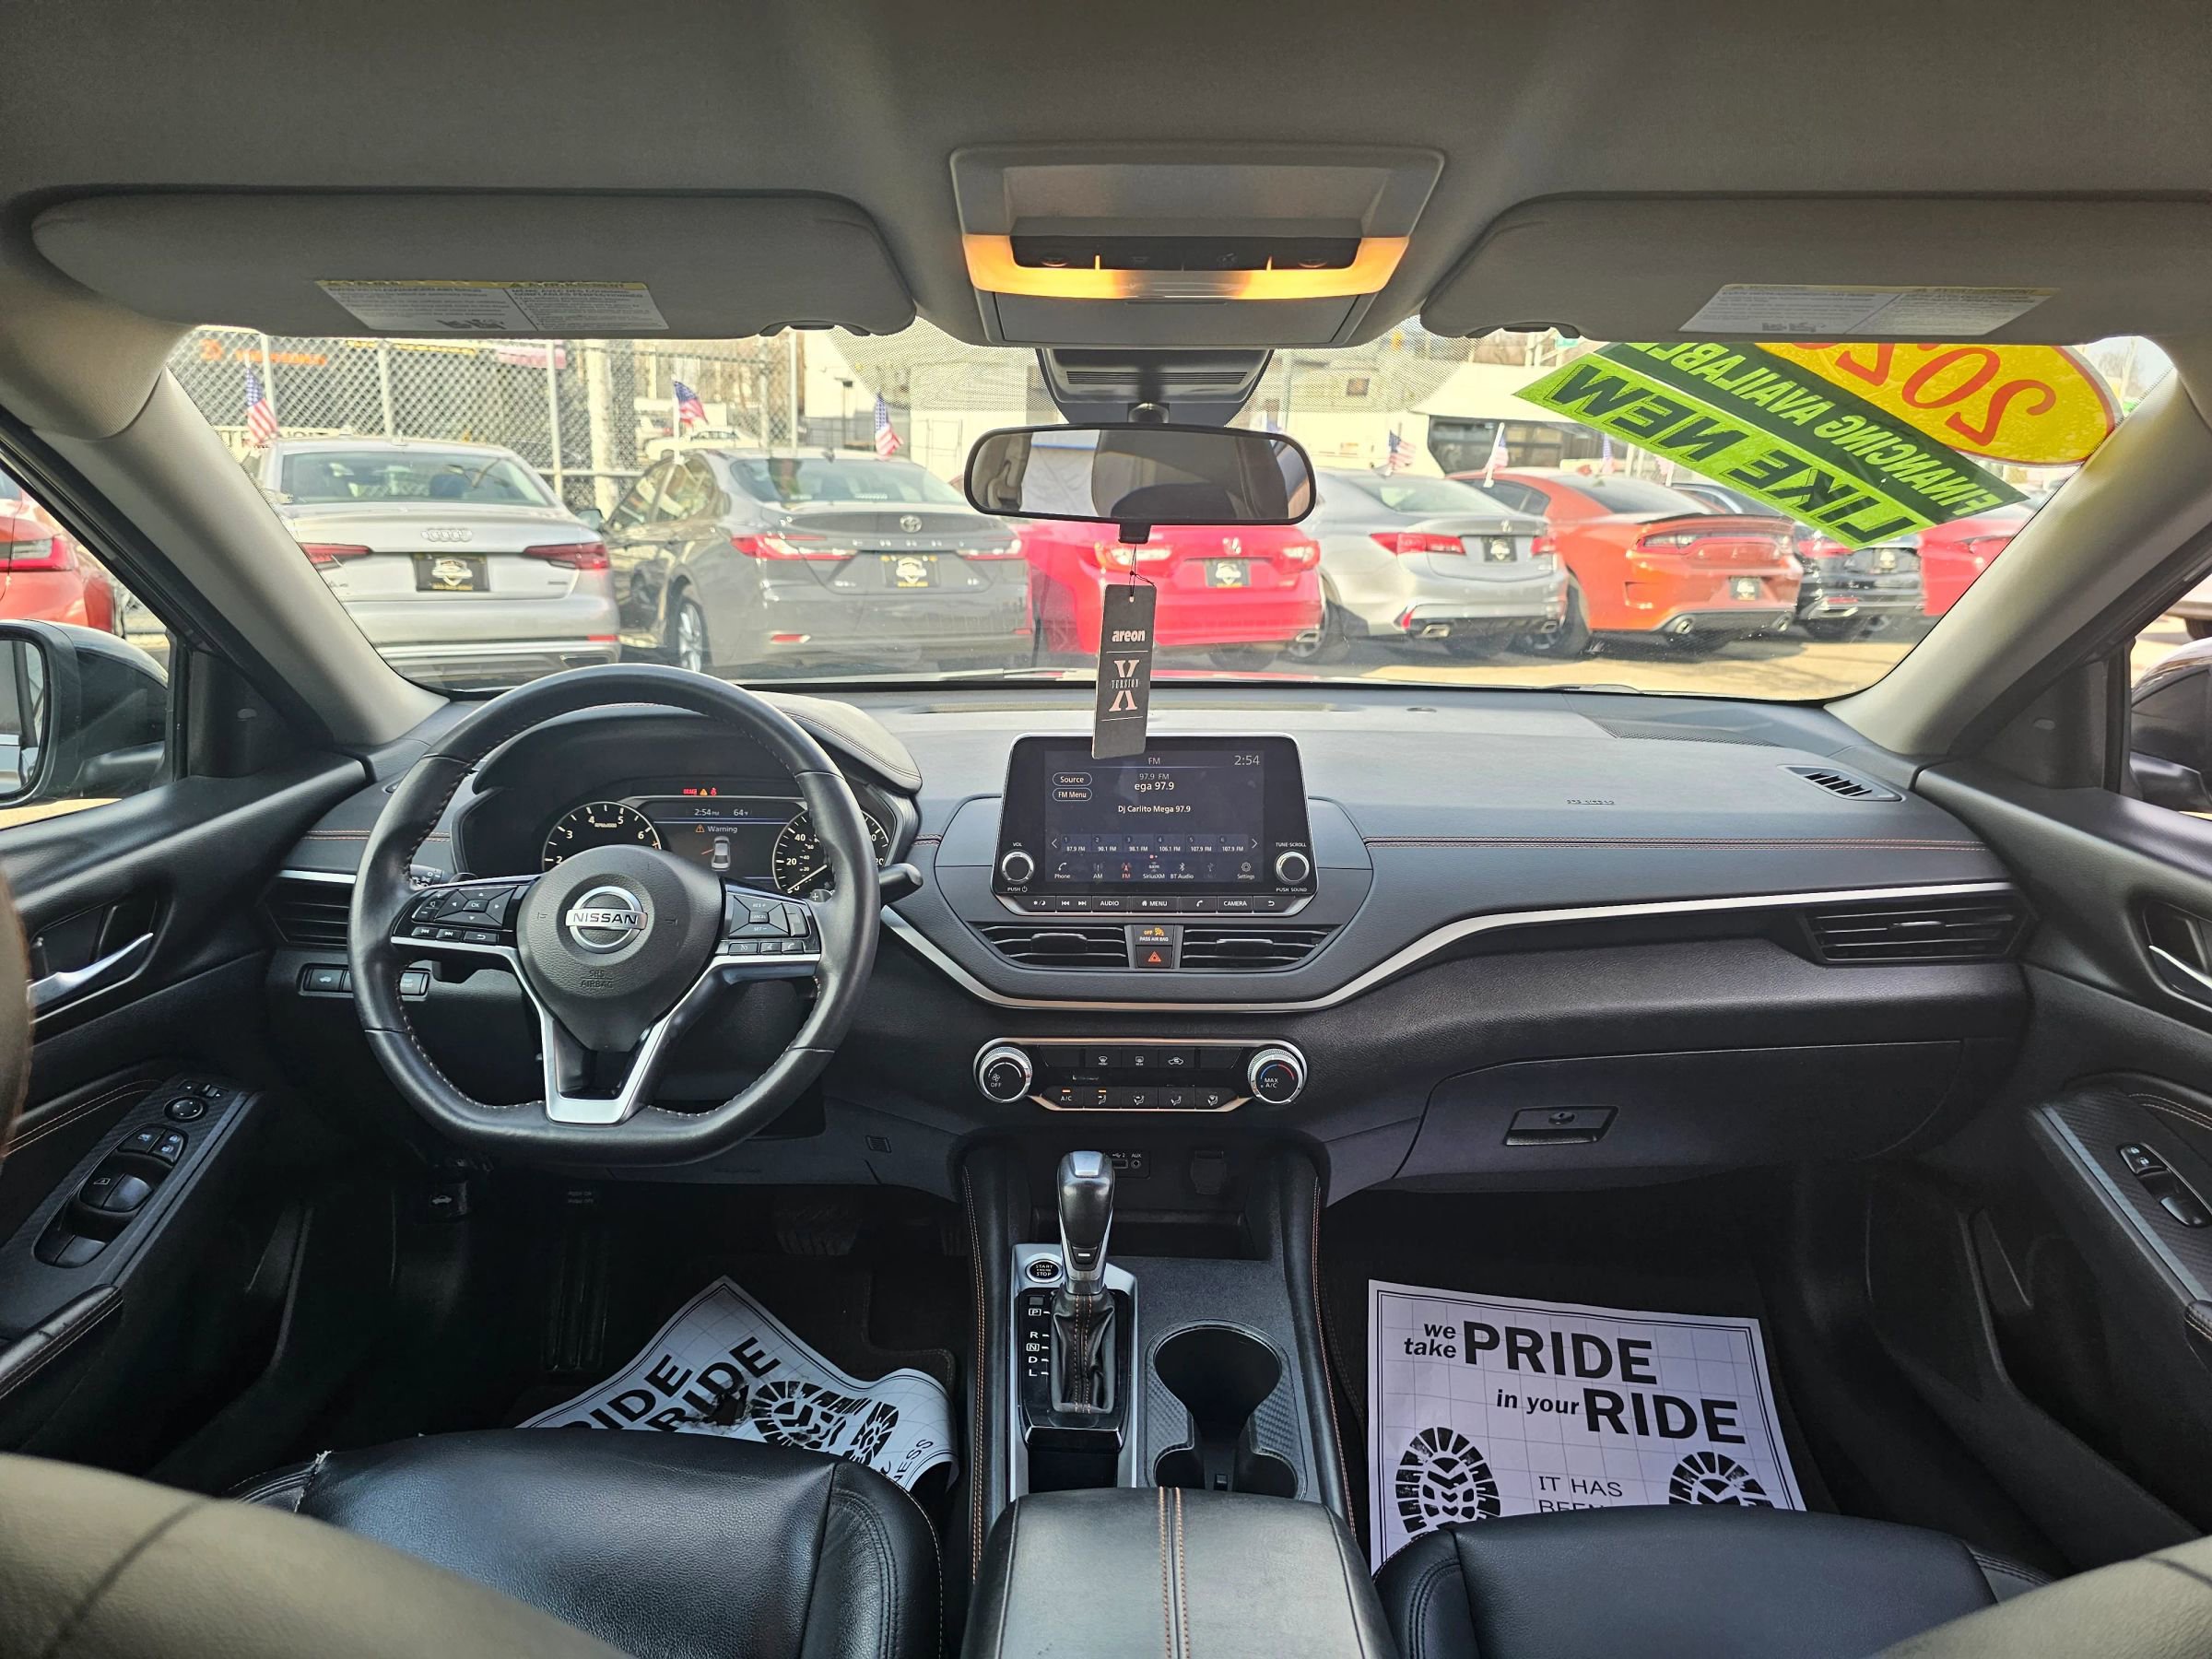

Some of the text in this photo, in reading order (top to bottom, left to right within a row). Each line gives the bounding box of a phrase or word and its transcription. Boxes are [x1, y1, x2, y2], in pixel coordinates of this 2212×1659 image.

[1112, 629, 1146, 642] areon
[1234, 755, 1260, 766] 2:54
[1134, 782, 1175, 793] ega 97.9
[1118, 806, 1125, 814] Dj
[1127, 805, 1151, 813] Carlito
[1153, 806, 1174, 814] Mega
[588, 816, 595, 824] 4
[618, 816, 624, 824] 5
[566, 830, 573, 839] 3
[637, 830, 644, 840] 6
[707, 826, 738, 834] Warning
[794, 833, 806, 841] 40
[556, 855, 563, 865] 2
[573, 912, 638, 924] NISSAN
[580, 980, 614, 988] AIRBAG
[1030, 1331, 1039, 1339] R
[1423, 1323, 1456, 1339] we
[1404, 1320, 1657, 1384] take PRIDE
[1029, 1369, 1038, 1377] L
[1497, 1387, 1746, 1444] in your RIDE
[1538, 1476, 1623, 1497] IT HAS
